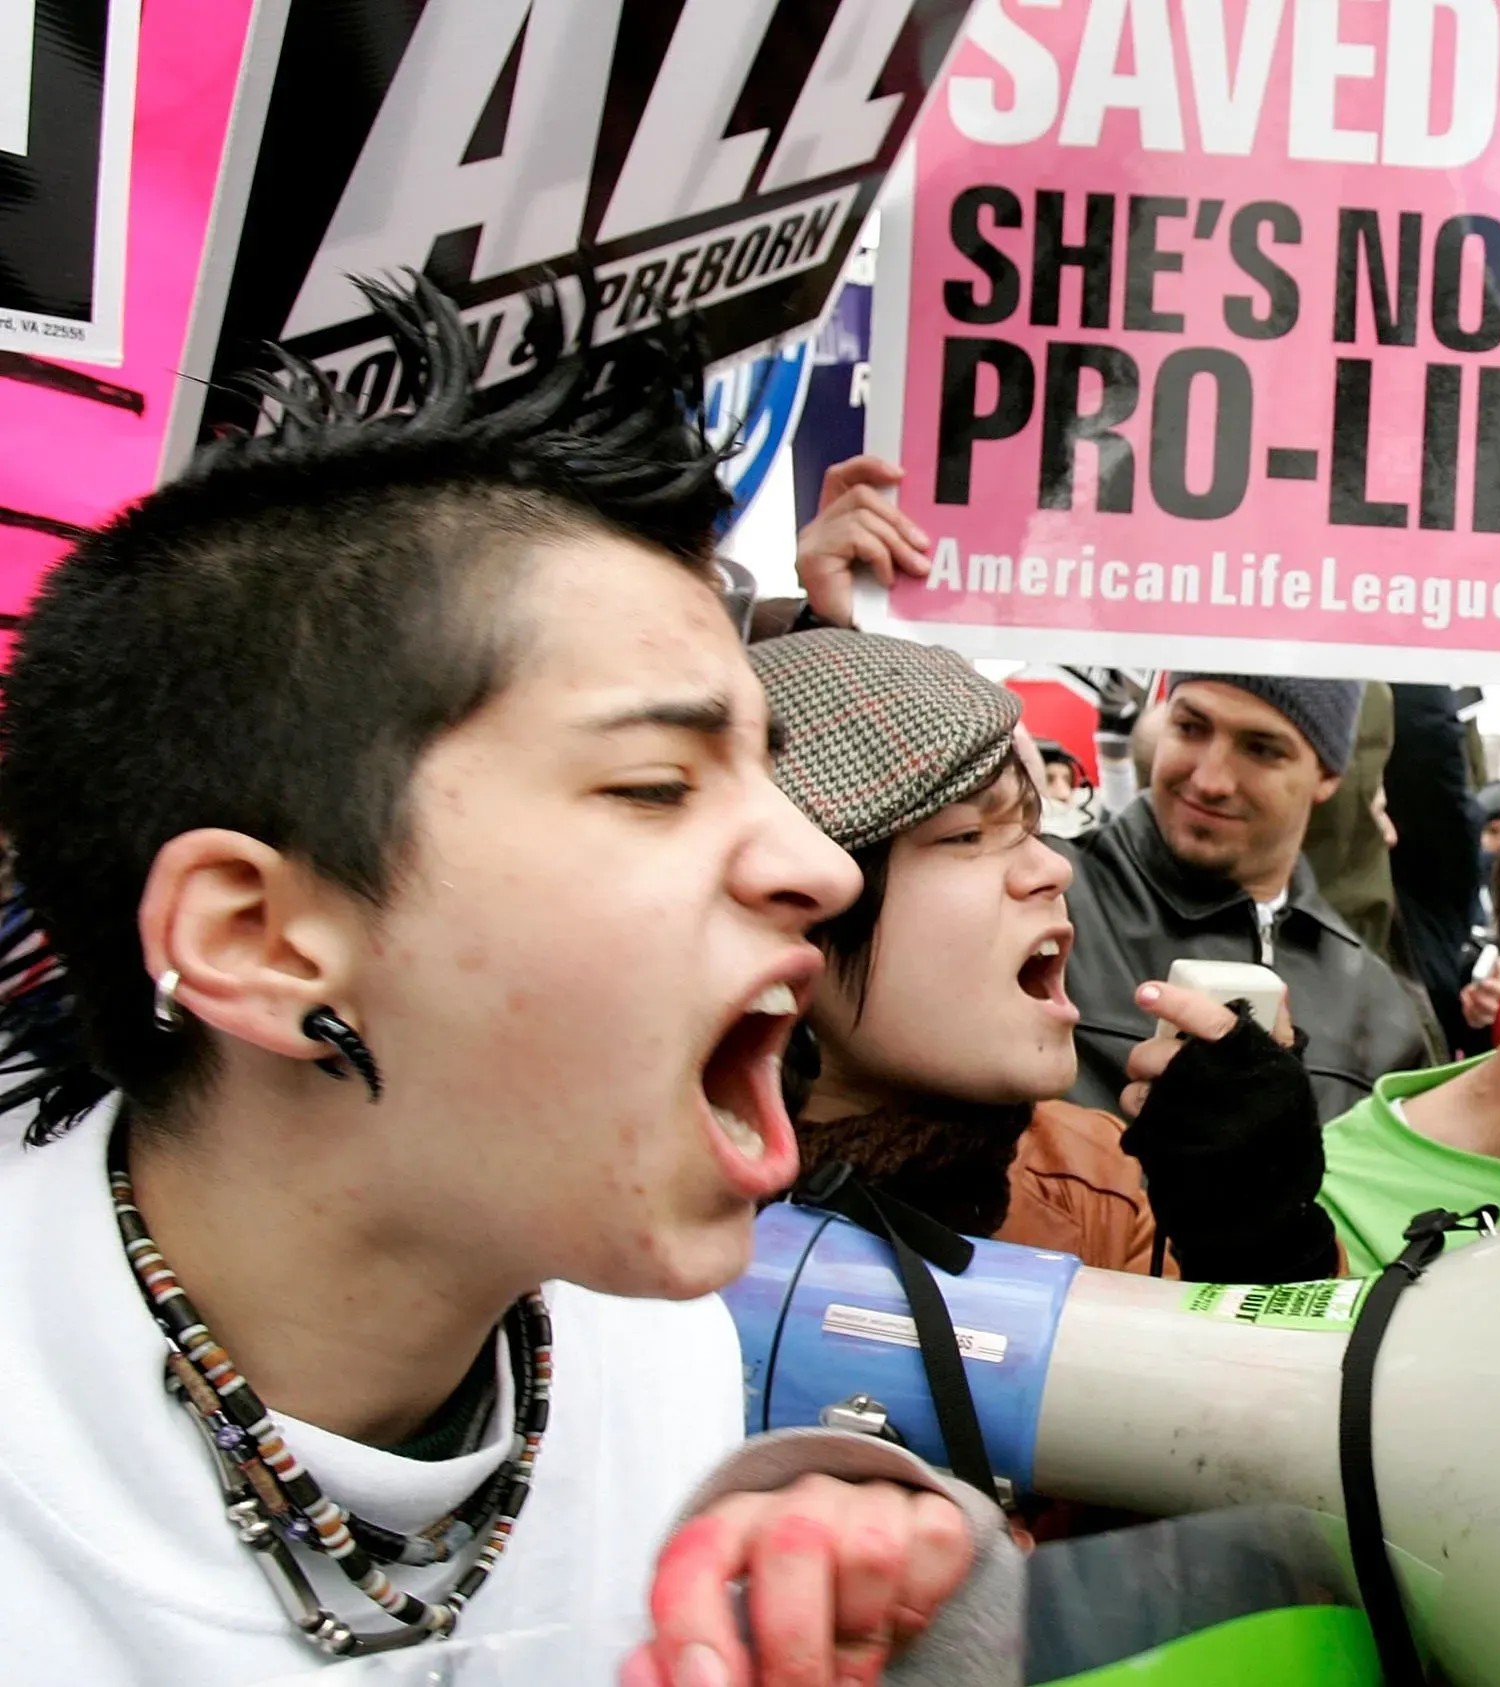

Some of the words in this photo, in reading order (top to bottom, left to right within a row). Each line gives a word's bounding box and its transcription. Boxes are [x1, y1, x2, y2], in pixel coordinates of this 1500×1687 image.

[947, 0, 1500, 169] SAVED
[594, 200, 840, 329] PREBORN
[943, 185, 1302, 342] SHE'S
